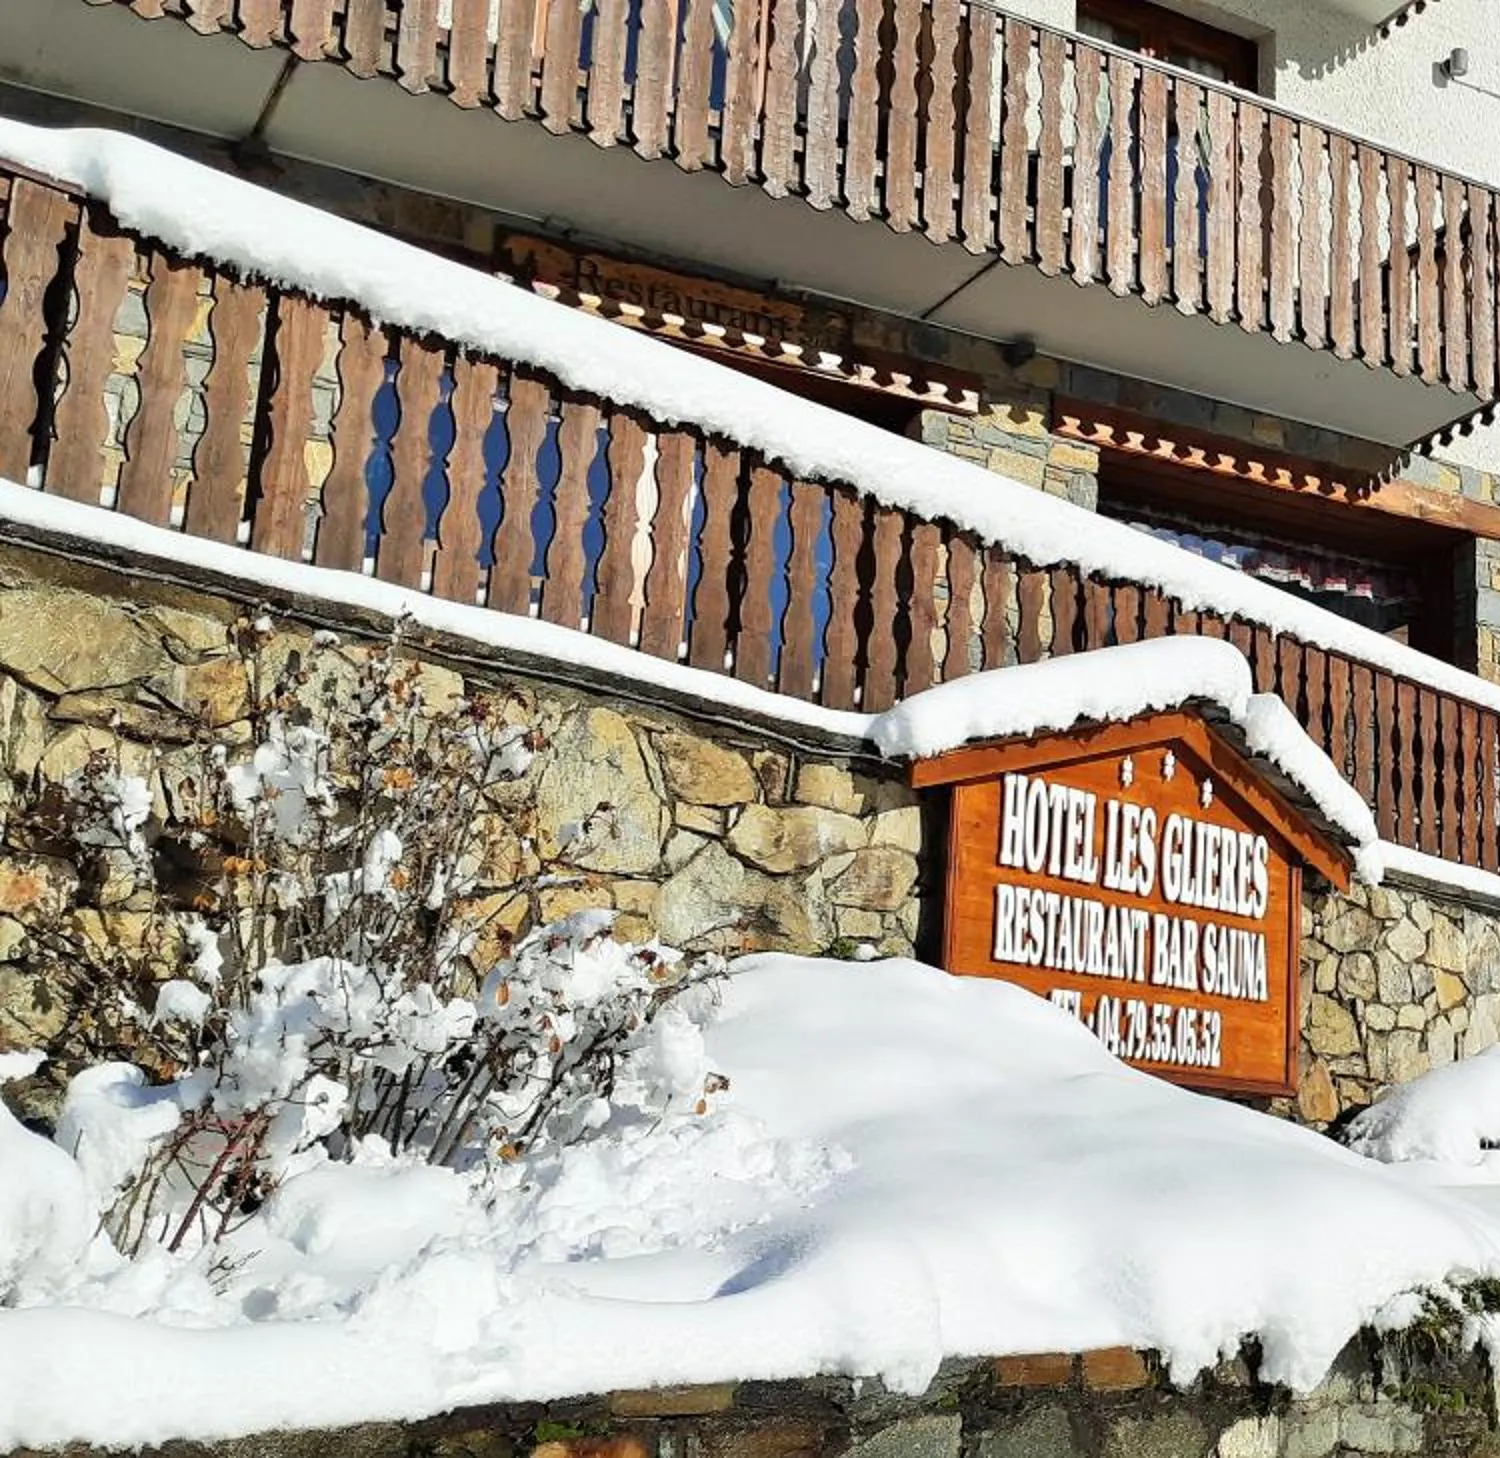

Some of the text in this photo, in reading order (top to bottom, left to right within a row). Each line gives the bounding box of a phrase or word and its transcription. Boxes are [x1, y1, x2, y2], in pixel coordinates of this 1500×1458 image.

[574, 254, 791, 341] Restaurant
[999, 772, 1269, 919] HOTEL LES GLIERES
[994, 883, 1269, 1001] RESTAURANT BAR SAUNA
[1098, 994, 1222, 1068] 04.79.55.05.52
